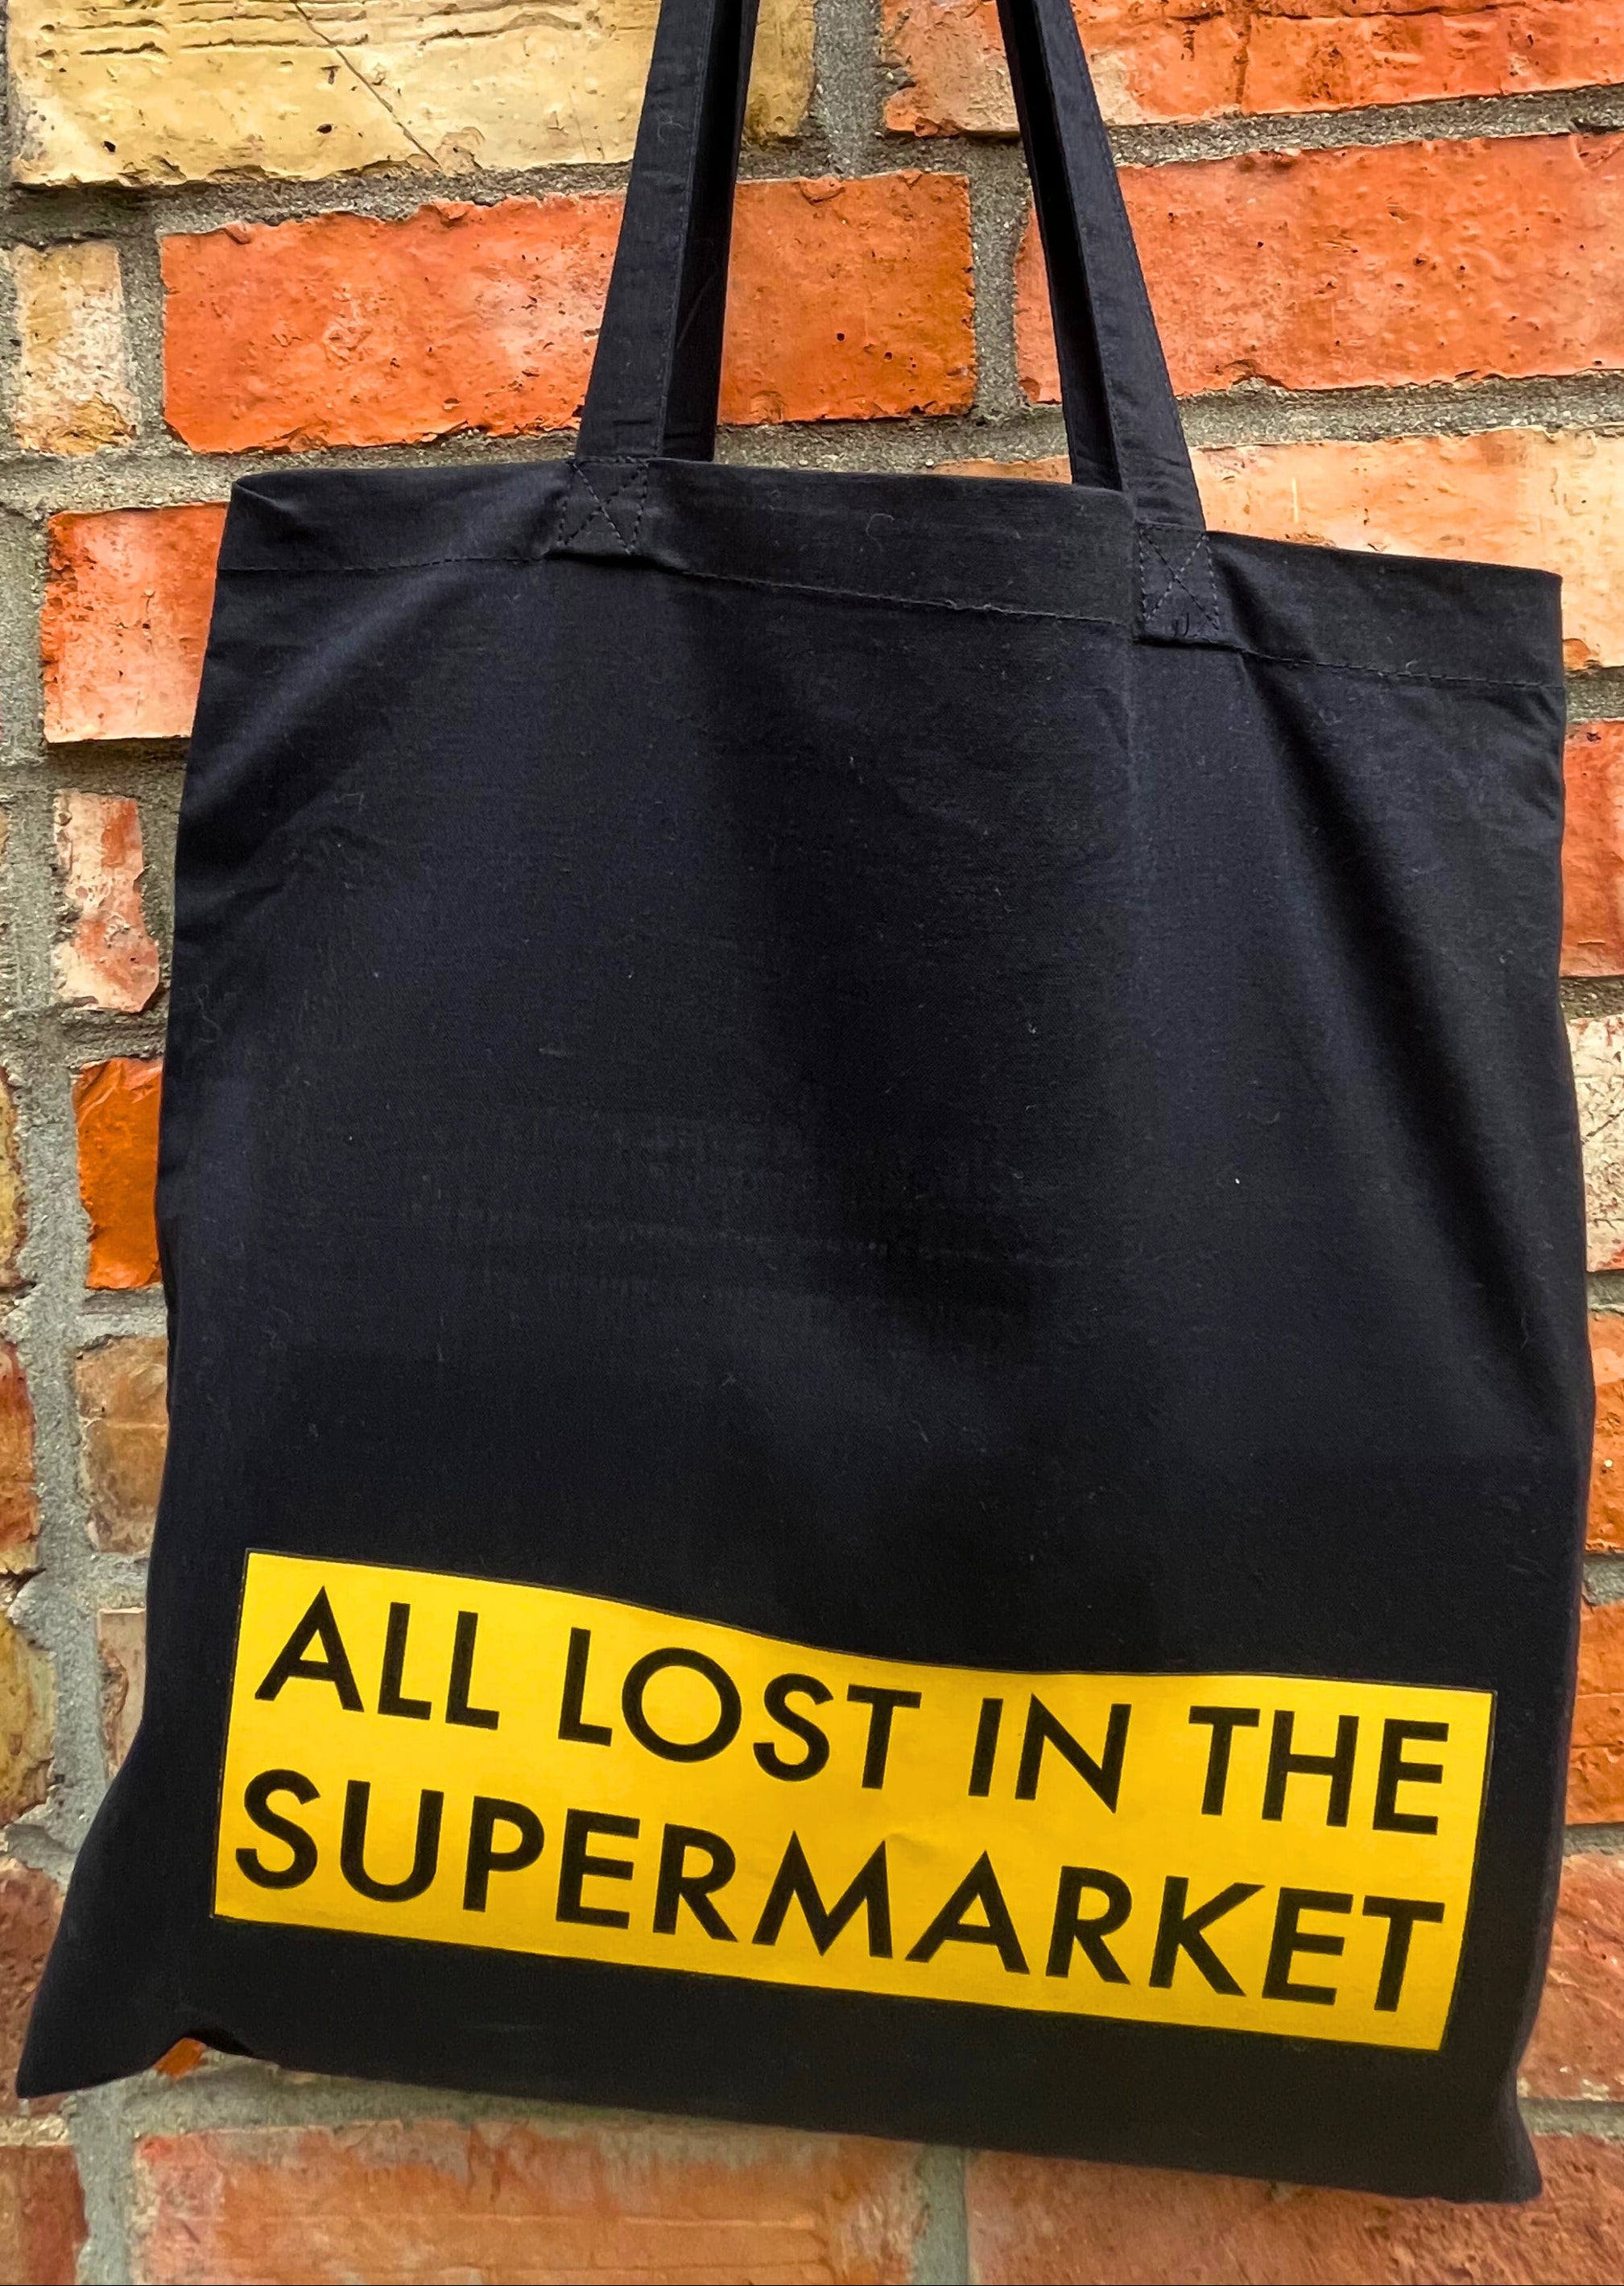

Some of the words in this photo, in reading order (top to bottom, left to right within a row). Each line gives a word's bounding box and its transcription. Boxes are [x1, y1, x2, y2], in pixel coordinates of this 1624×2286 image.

[254, 1585, 500, 1730] ALL
[557, 1627, 923, 1790] LOST
[968, 1693, 1132, 1816] IN
[1188, 1705, 1449, 1836] THE
[235, 1768, 1445, 2013] SUPERMARKET
